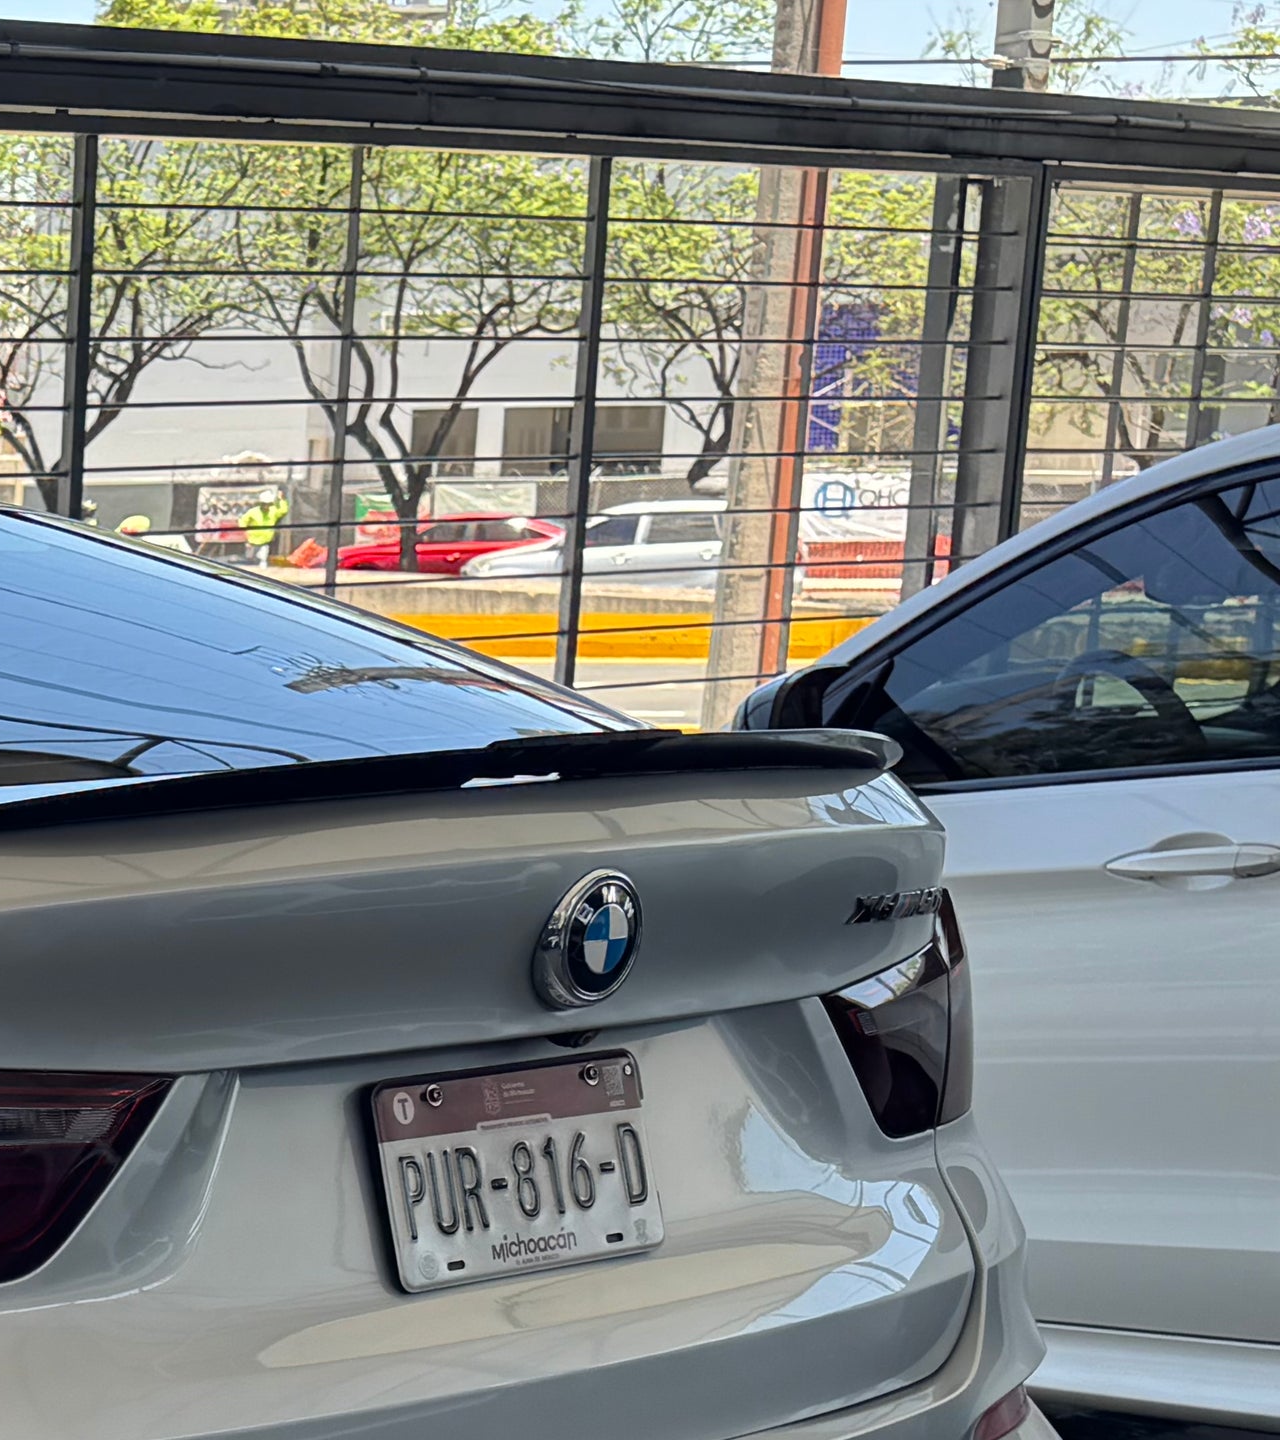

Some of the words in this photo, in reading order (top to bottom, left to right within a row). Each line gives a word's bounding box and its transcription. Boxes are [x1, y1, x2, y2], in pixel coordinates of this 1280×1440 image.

[576, 886, 635, 925] BMW
[396, 1097, 409, 1121] T
[398, 1122, 648, 1242] PUR-816-D
[491, 1227, 578, 1262] Michoacán
